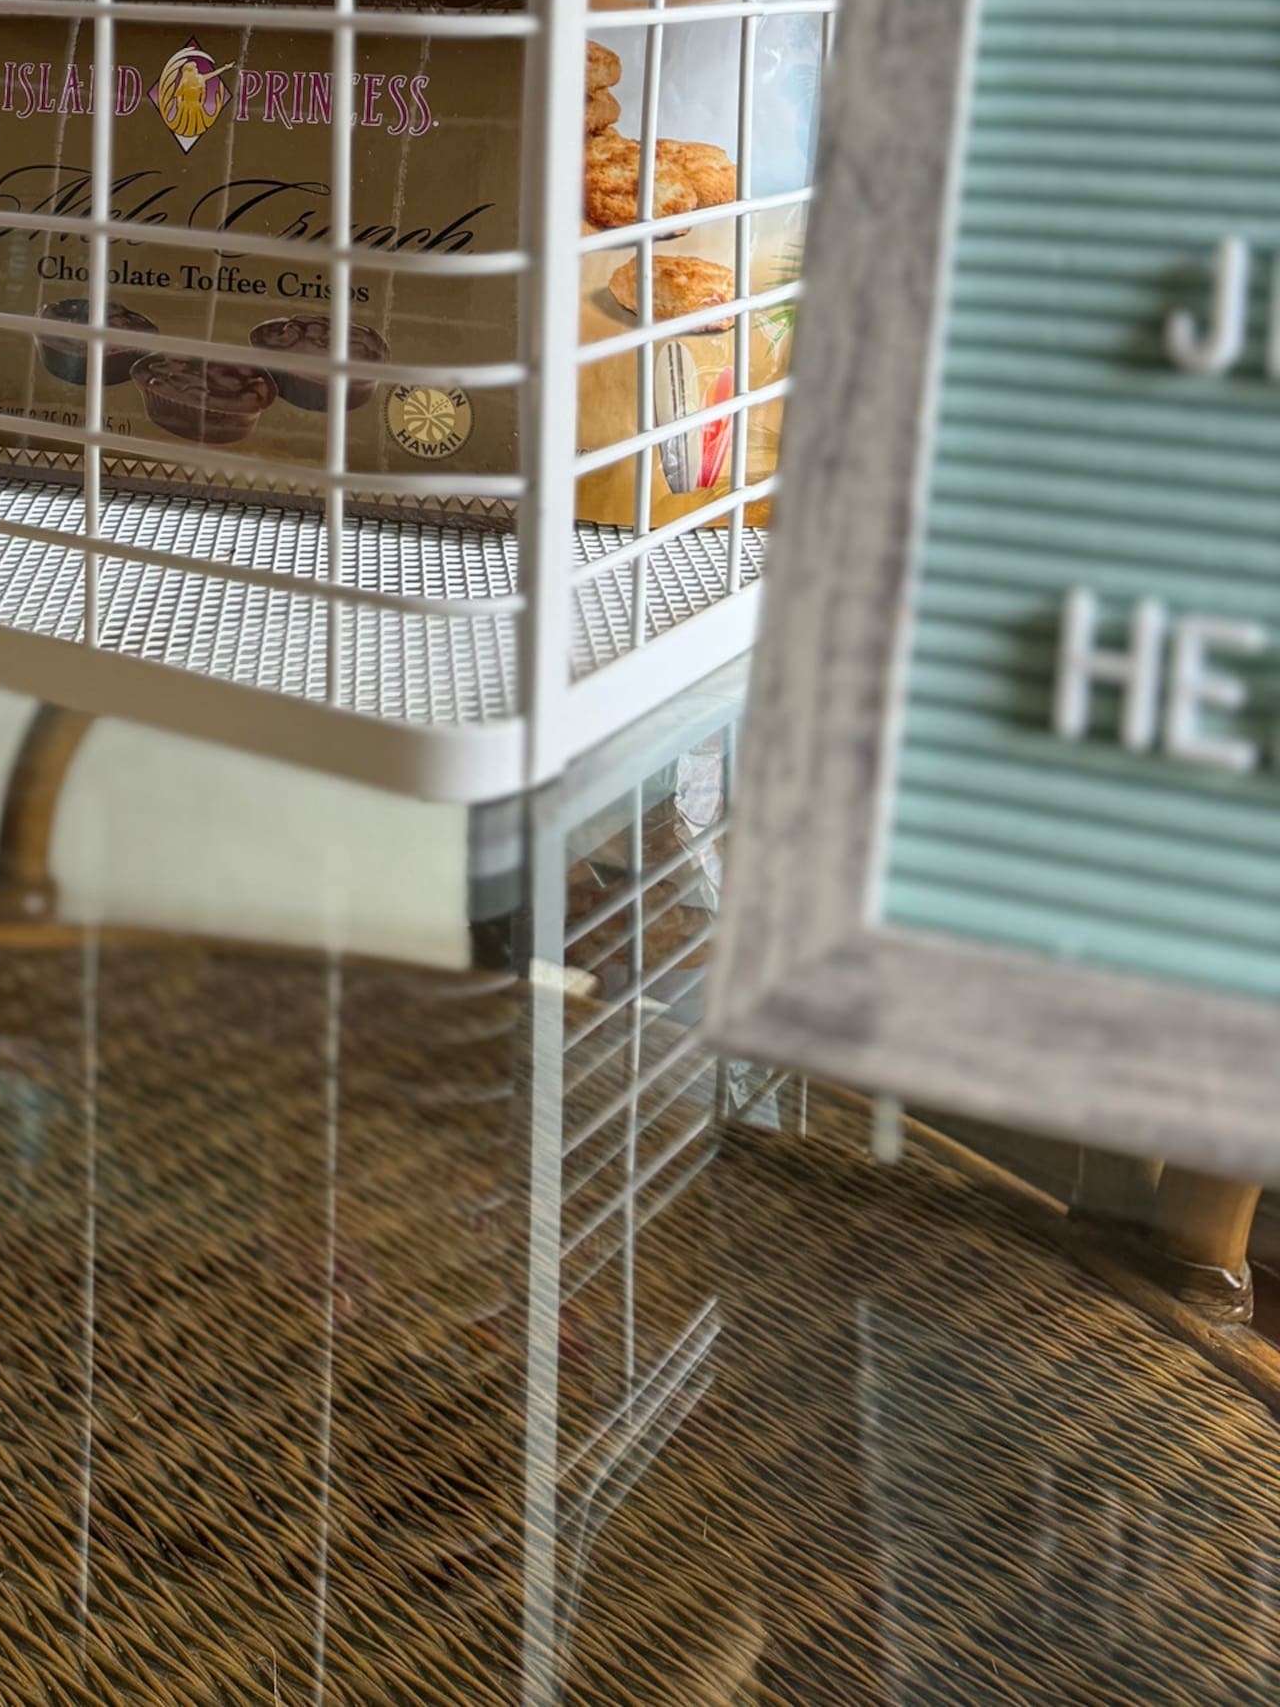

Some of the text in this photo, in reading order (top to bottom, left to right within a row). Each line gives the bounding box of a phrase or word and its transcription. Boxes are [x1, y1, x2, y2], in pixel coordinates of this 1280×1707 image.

[37, 255, 170, 288] Choolate
[180, 264, 267, 295] Toffee
[448, 387, 467, 408] IN
[396, 429, 462, 455] HAWAII
